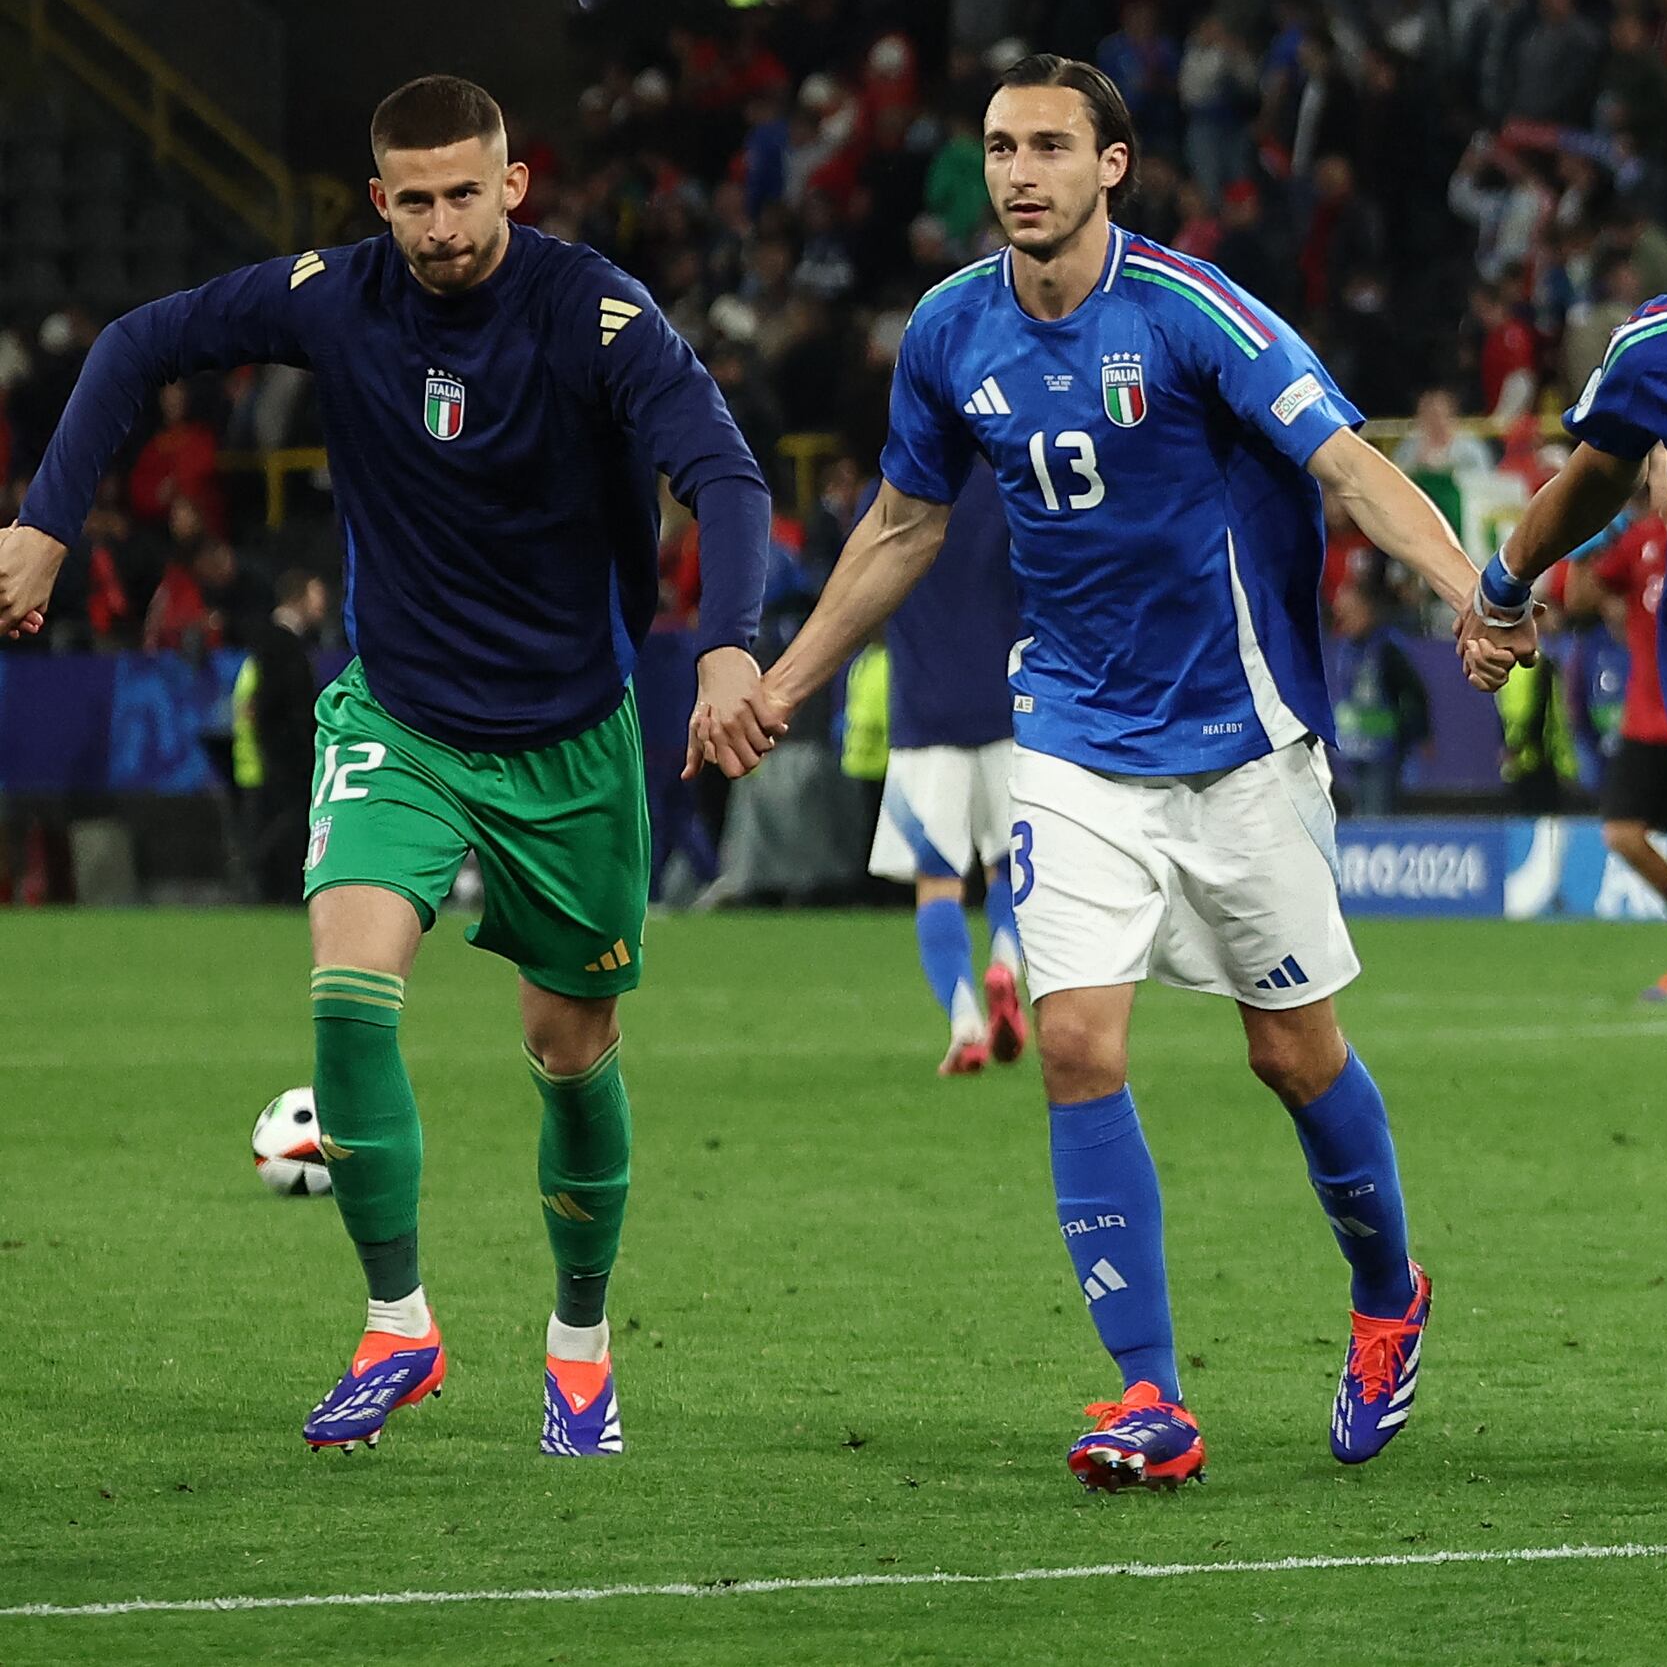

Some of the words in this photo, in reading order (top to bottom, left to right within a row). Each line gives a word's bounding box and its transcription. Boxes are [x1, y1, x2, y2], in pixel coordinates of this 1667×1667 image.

[1105, 369, 1138, 383] ITALIA
[429, 383, 460, 400] ITALIA
[1029, 430, 1106, 511] 13
[1203, 722, 1243, 735] HEAT.RDY
[313, 742, 386, 808] 12
